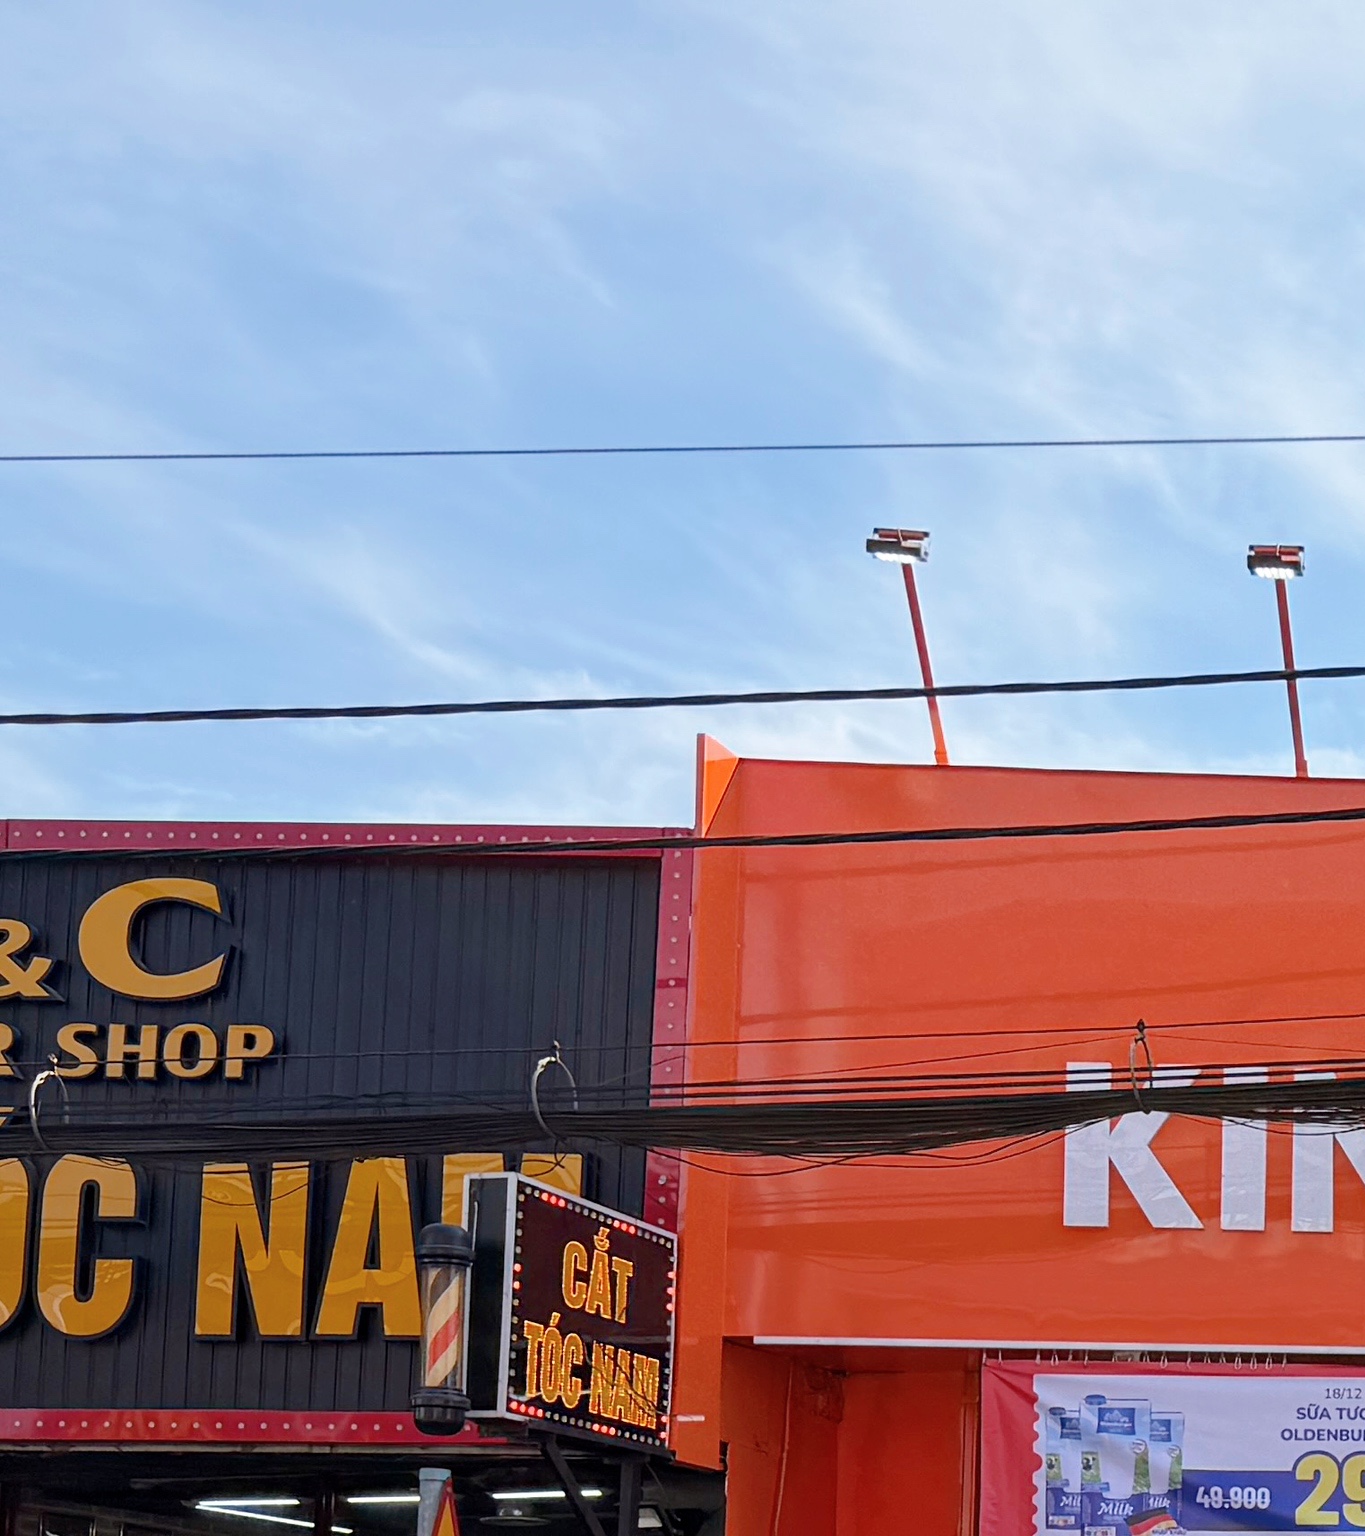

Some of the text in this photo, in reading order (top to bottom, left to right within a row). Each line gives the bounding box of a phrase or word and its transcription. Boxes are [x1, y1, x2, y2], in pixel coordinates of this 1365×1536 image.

[55, 1022, 276, 1080] SHOP
[562, 1226, 634, 1324] CẮT
[523, 1312, 660, 1430] TÓC NAM
[1325, 1387, 1360, 1400] 18/12
[1296, 1404, 1332, 1421] SỮA
[1098, 1502, 1133, 1516] Milk
